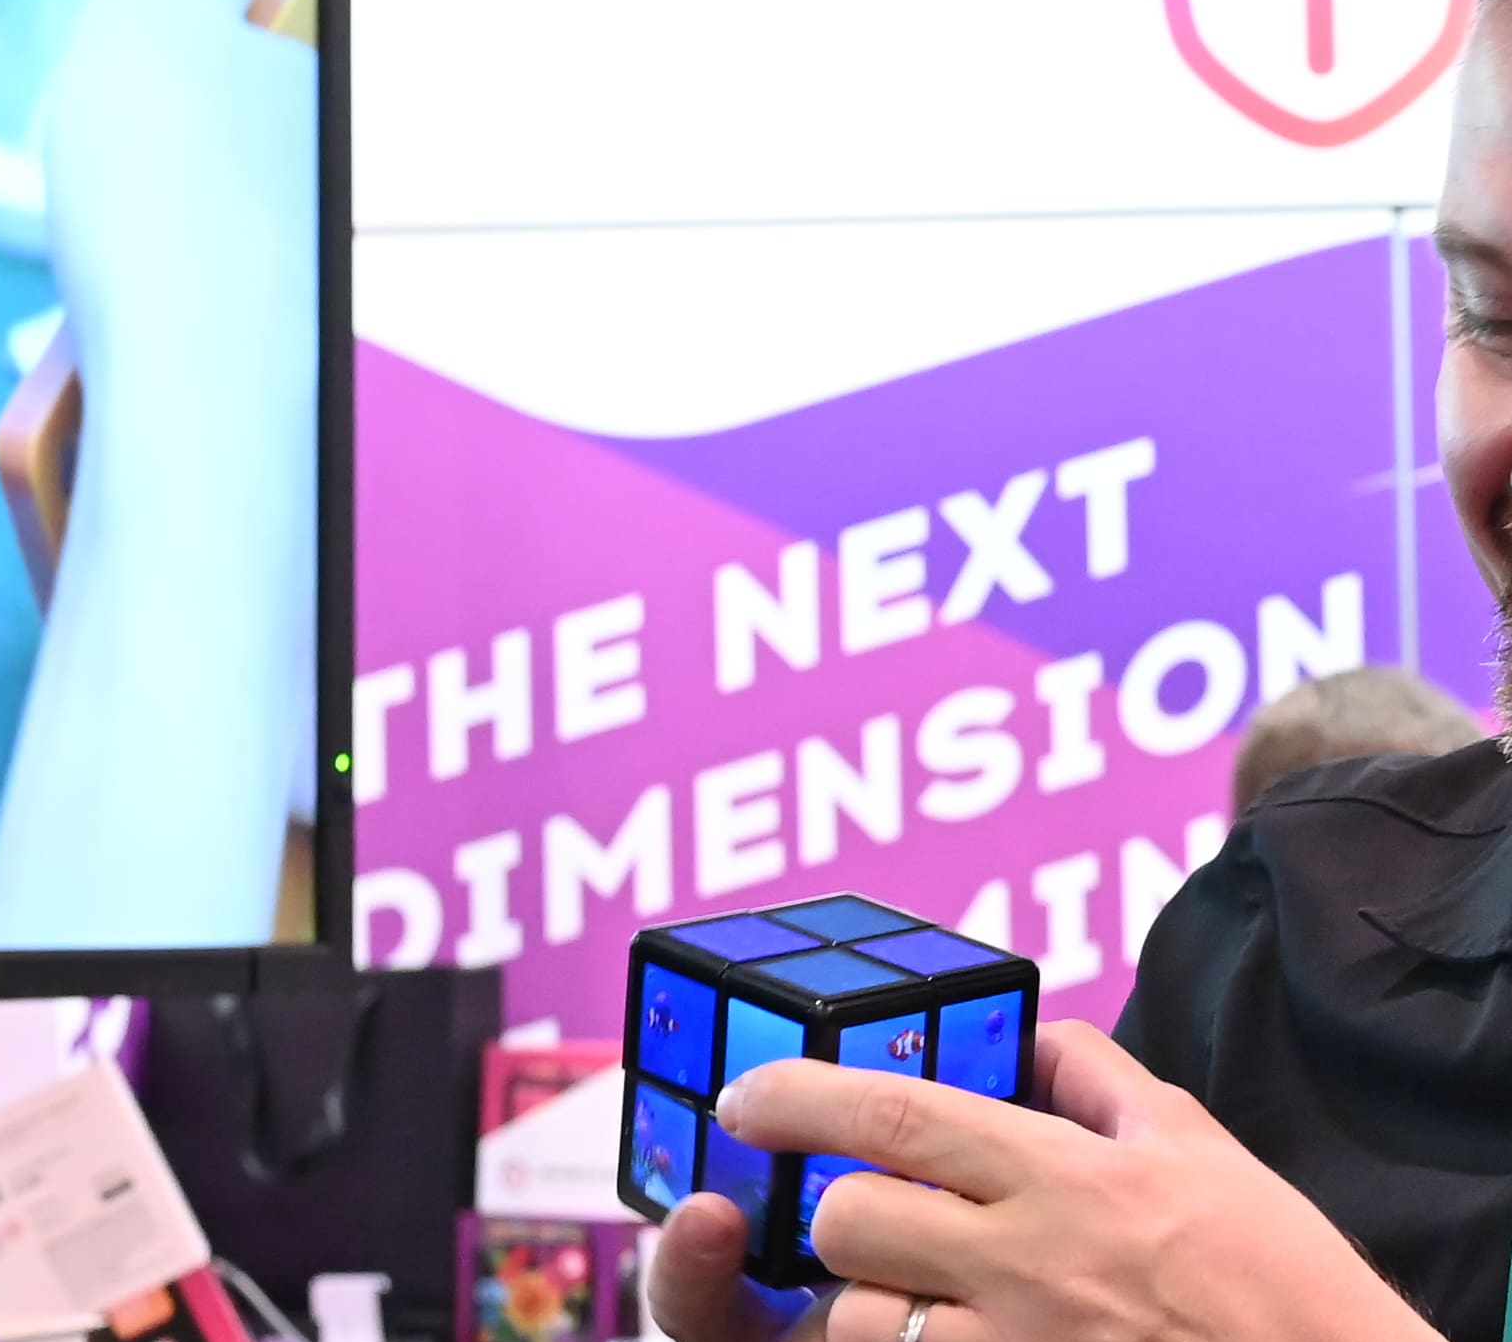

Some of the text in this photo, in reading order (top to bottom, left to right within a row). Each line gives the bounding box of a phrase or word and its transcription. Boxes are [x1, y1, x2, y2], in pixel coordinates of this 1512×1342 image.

[353, 435, 1156, 807] THE NEXT
[353, 571, 1366, 973] DIMENSION
